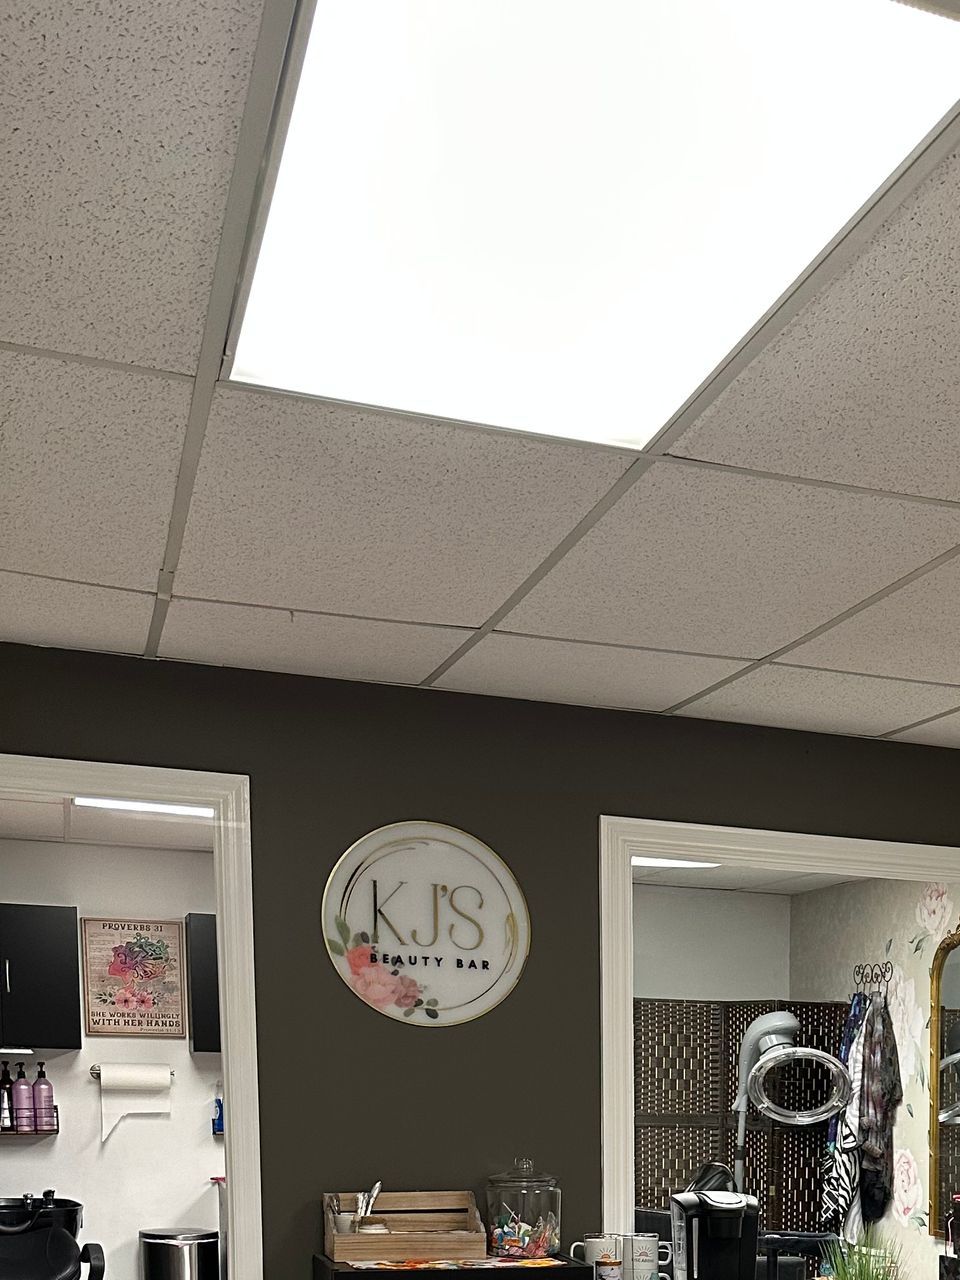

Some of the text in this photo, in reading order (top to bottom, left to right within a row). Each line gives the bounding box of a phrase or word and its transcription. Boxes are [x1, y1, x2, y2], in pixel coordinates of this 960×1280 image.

[370, 879, 485, 951] KJ'S
[102, 922, 151, 931] PROVERBS
[369, 953, 490, 970] BEAUTY BAR
[108, 1011, 137, 1019] WORKS
[139, 1012, 180, 1020] WILLINGLY
[91, 1018, 181, 1028] WITH HER HANDS
